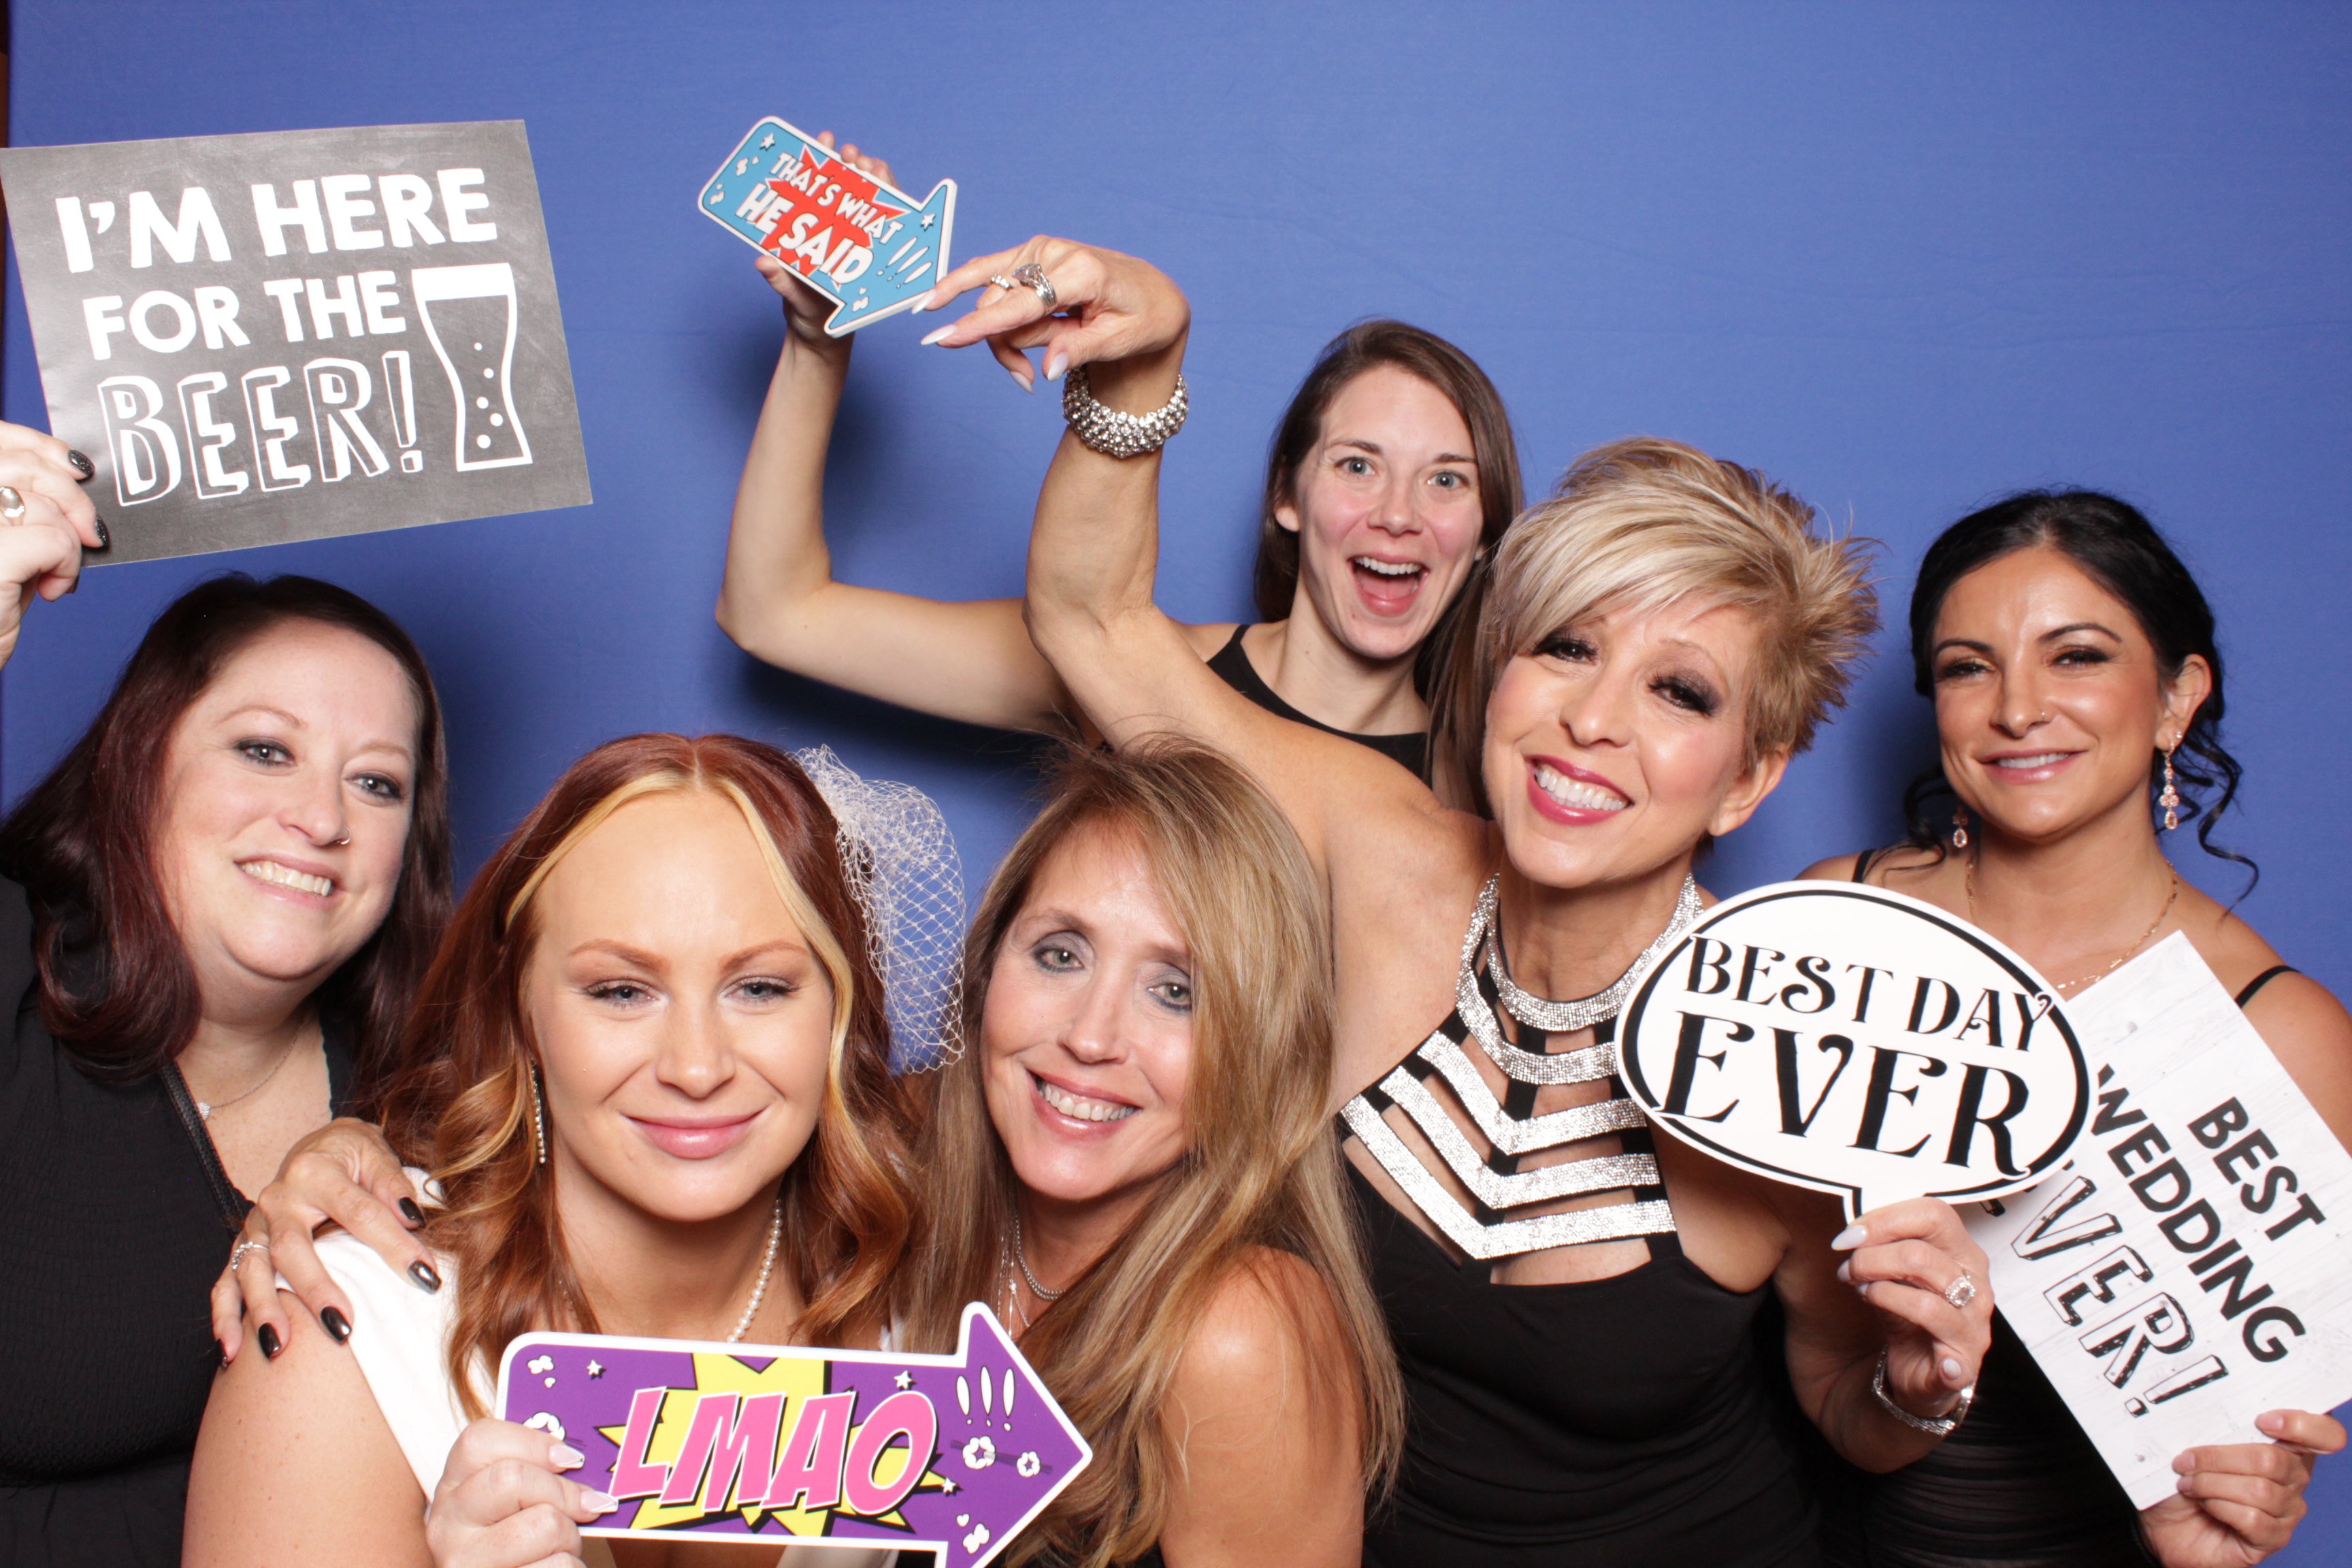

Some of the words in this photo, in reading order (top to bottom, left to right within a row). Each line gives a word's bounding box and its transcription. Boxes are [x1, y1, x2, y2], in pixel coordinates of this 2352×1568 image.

[56, 186, 231, 273] I'M
[251, 167, 497, 257] HERE
[735, 182, 795, 235] HE
[777, 212, 873, 284] SAID
[834, 192, 904, 244] WHAT
[82, 286, 250, 360] FOR
[264, 270, 406, 342] THE
[97, 350, 423, 506] BEER!
[1684, 934, 1894, 1024] BEST
[1905, 976, 2053, 1052] DAY
[1654, 1011, 2031, 1178] EVER
[2187, 1096, 2327, 1242] BEST
[1979, 1157, 2230, 1418] VER!
[608, 1386, 939, 1516] LMAO
